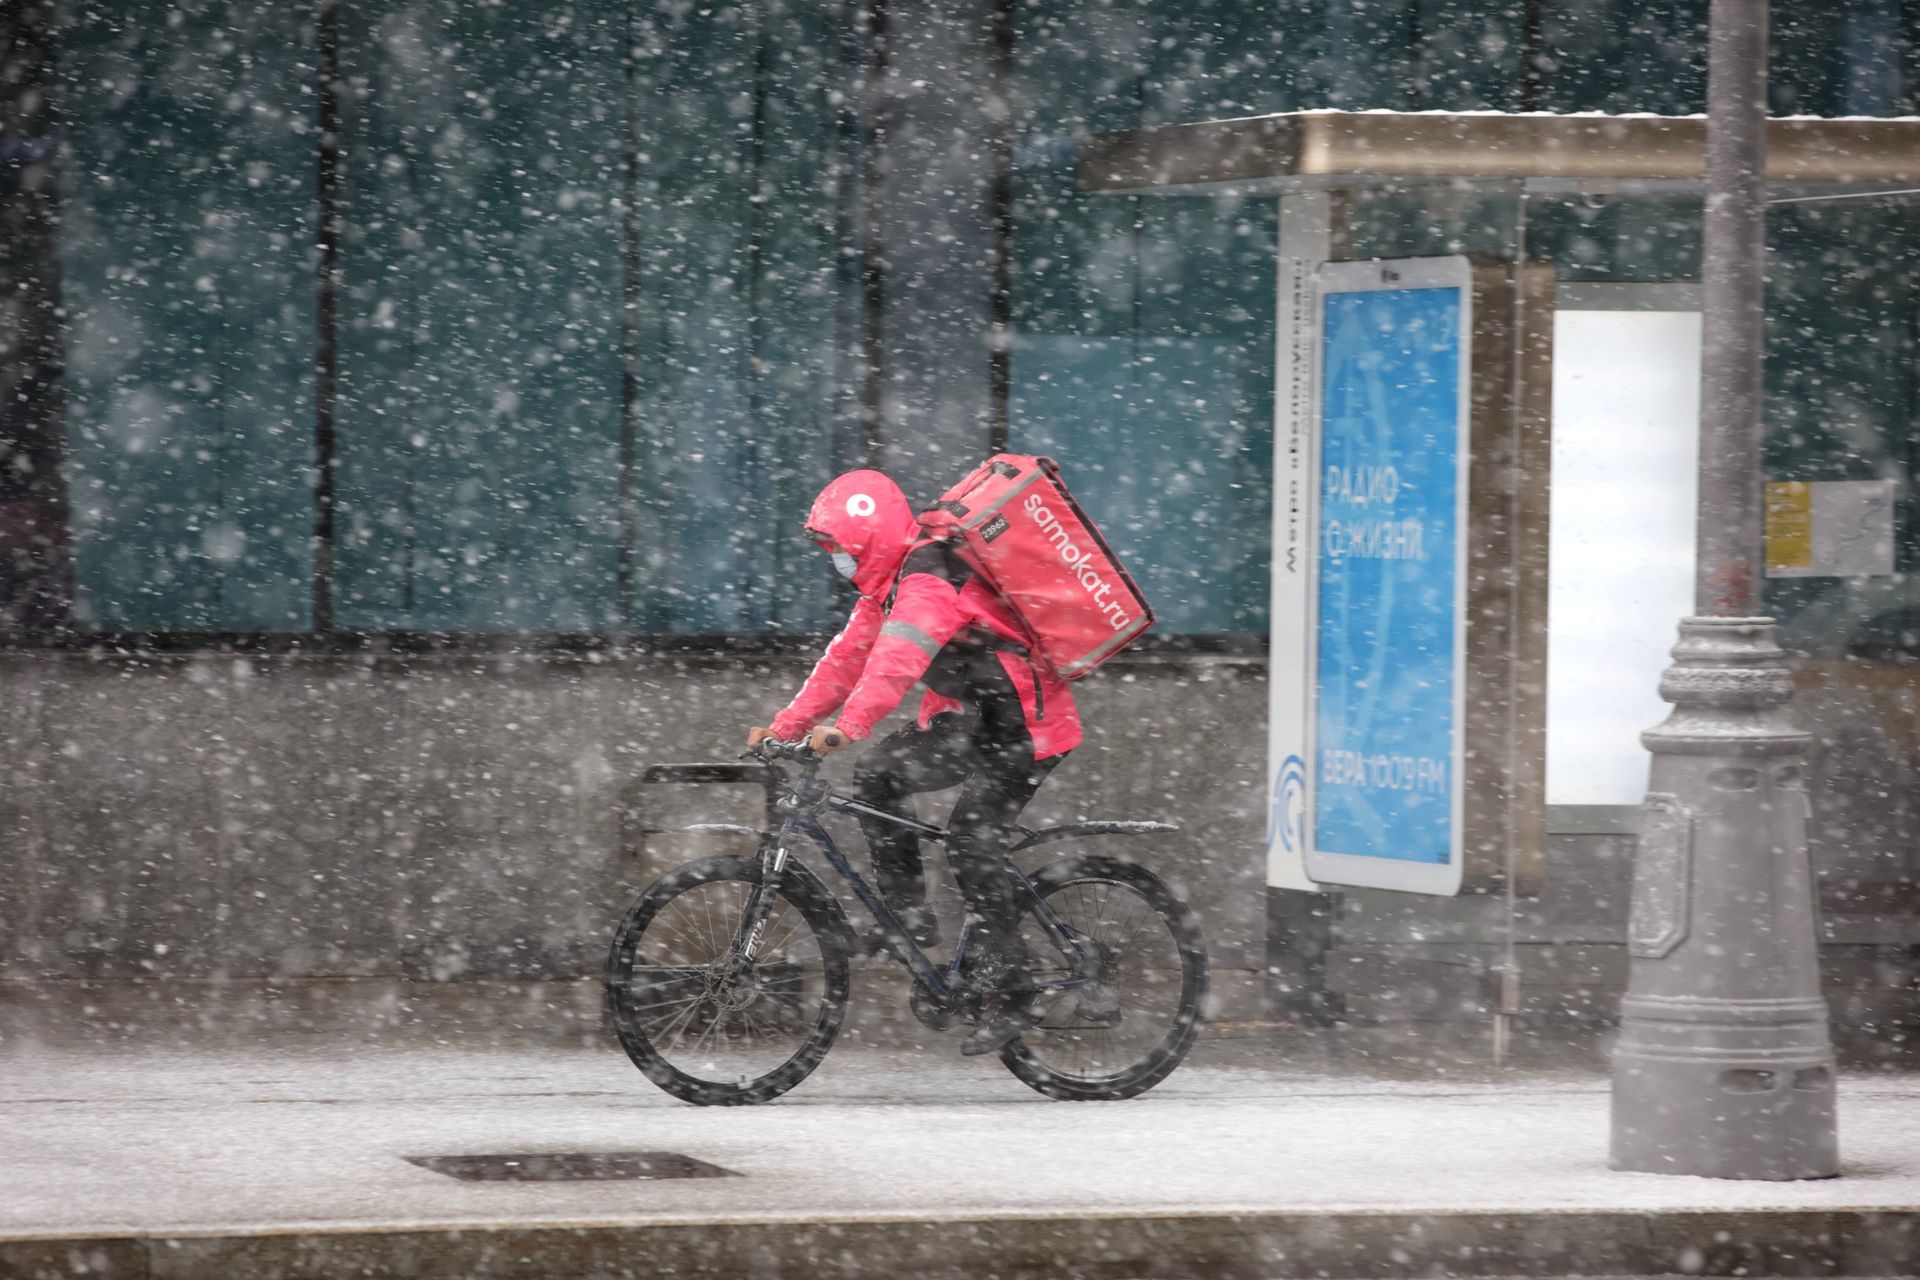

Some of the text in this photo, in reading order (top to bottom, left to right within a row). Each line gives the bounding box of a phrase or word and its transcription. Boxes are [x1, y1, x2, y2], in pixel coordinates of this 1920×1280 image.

[1327, 465, 1399, 504] РАДИО
[982, 518, 1008, 539] 23962
[1024, 493, 1131, 631] samokat.ru
